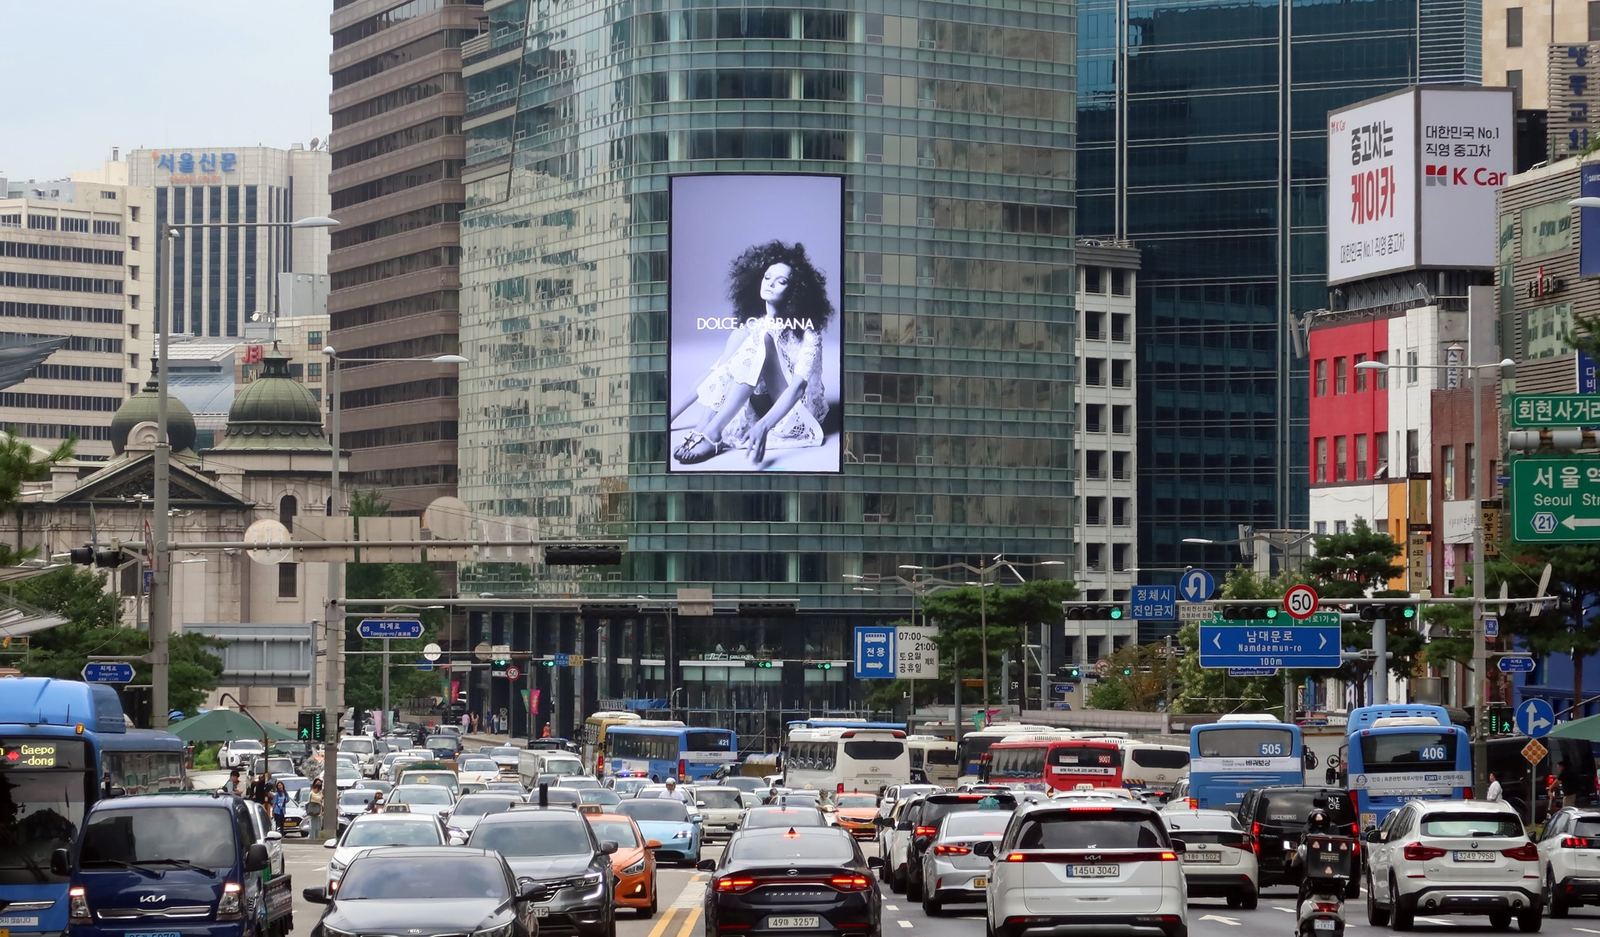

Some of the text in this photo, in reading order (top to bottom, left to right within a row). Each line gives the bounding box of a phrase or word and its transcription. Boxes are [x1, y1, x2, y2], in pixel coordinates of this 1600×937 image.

[1425, 125, 1500, 140] 대한민국 No.1
[1351, 120, 1394, 166] 중고차는
[1425, 143, 1491, 157] 직영 중고차
[157, 152, 237, 173] 서울신문
[1453, 167, 1508, 187] K Car
[1351, 165, 1396, 225] 케이카
[1340, 231, 1405, 264] 대한민국 No.1 직영 중고차
[696, 317, 738, 330] DOLCE
[746, 316, 815, 330] GABBANA
[1534, 493, 1573, 507] Seoul
[1538, 515, 1552, 530] 21
[1137, 589, 1171, 602] 정체시
[1291, 594, 1312, 612] 50
[1133, 604, 1174, 617] 진입금지
[1246, 631, 1294, 643] 남대문로
[866, 647, 886, 658] 전용
[915, 642, 936, 651] 21:00
[1238, 644, 1303, 652] Namdaemun-ro
[899, 652, 922, 661] 토요일
[1260, 657, 1284, 667] 100m
[899, 663, 922, 674] 공휴일
[718, 738, 729, 746] 421
[20, 744, 55, 756] Gaepo
[1261, 743, 1282, 755] 505
[1422, 747, 1445, 761] 406
[22, 756, 54, 766] -dong
[1097, 867, 1117, 875] 3042
[793, 917, 815, 926] 3257
